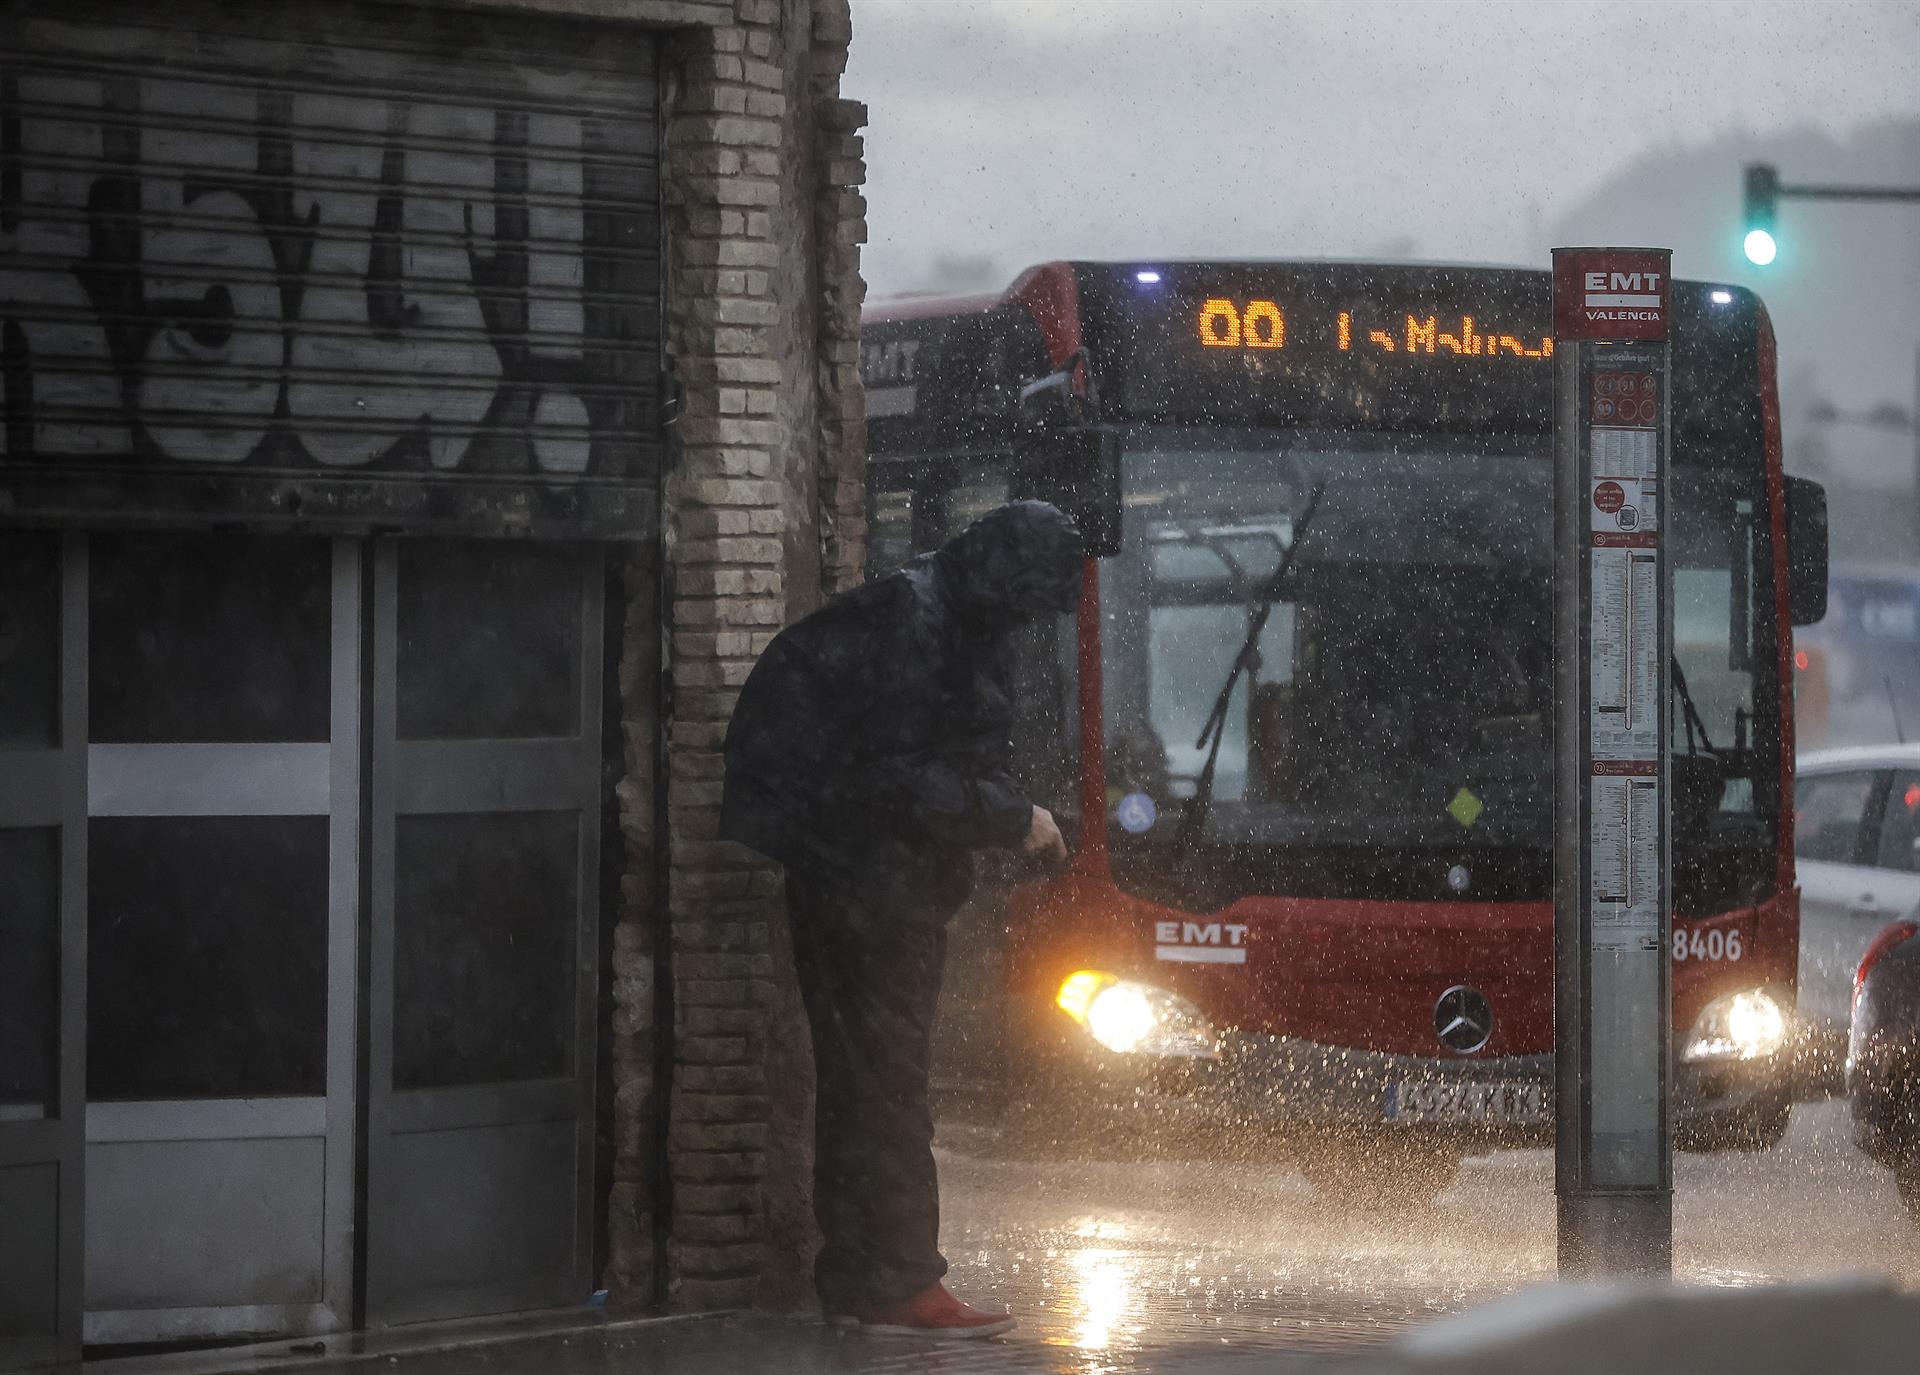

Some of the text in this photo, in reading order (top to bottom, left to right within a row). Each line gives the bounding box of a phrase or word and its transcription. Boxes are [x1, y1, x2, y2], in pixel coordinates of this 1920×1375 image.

[1585, 272, 1660, 291] EMT
[1585, 311, 1660, 321] VALENCIA
[861, 339, 920, 381] MT
[1155, 921, 1249, 945] EMT
[1671, 928, 1743, 961] 8406
